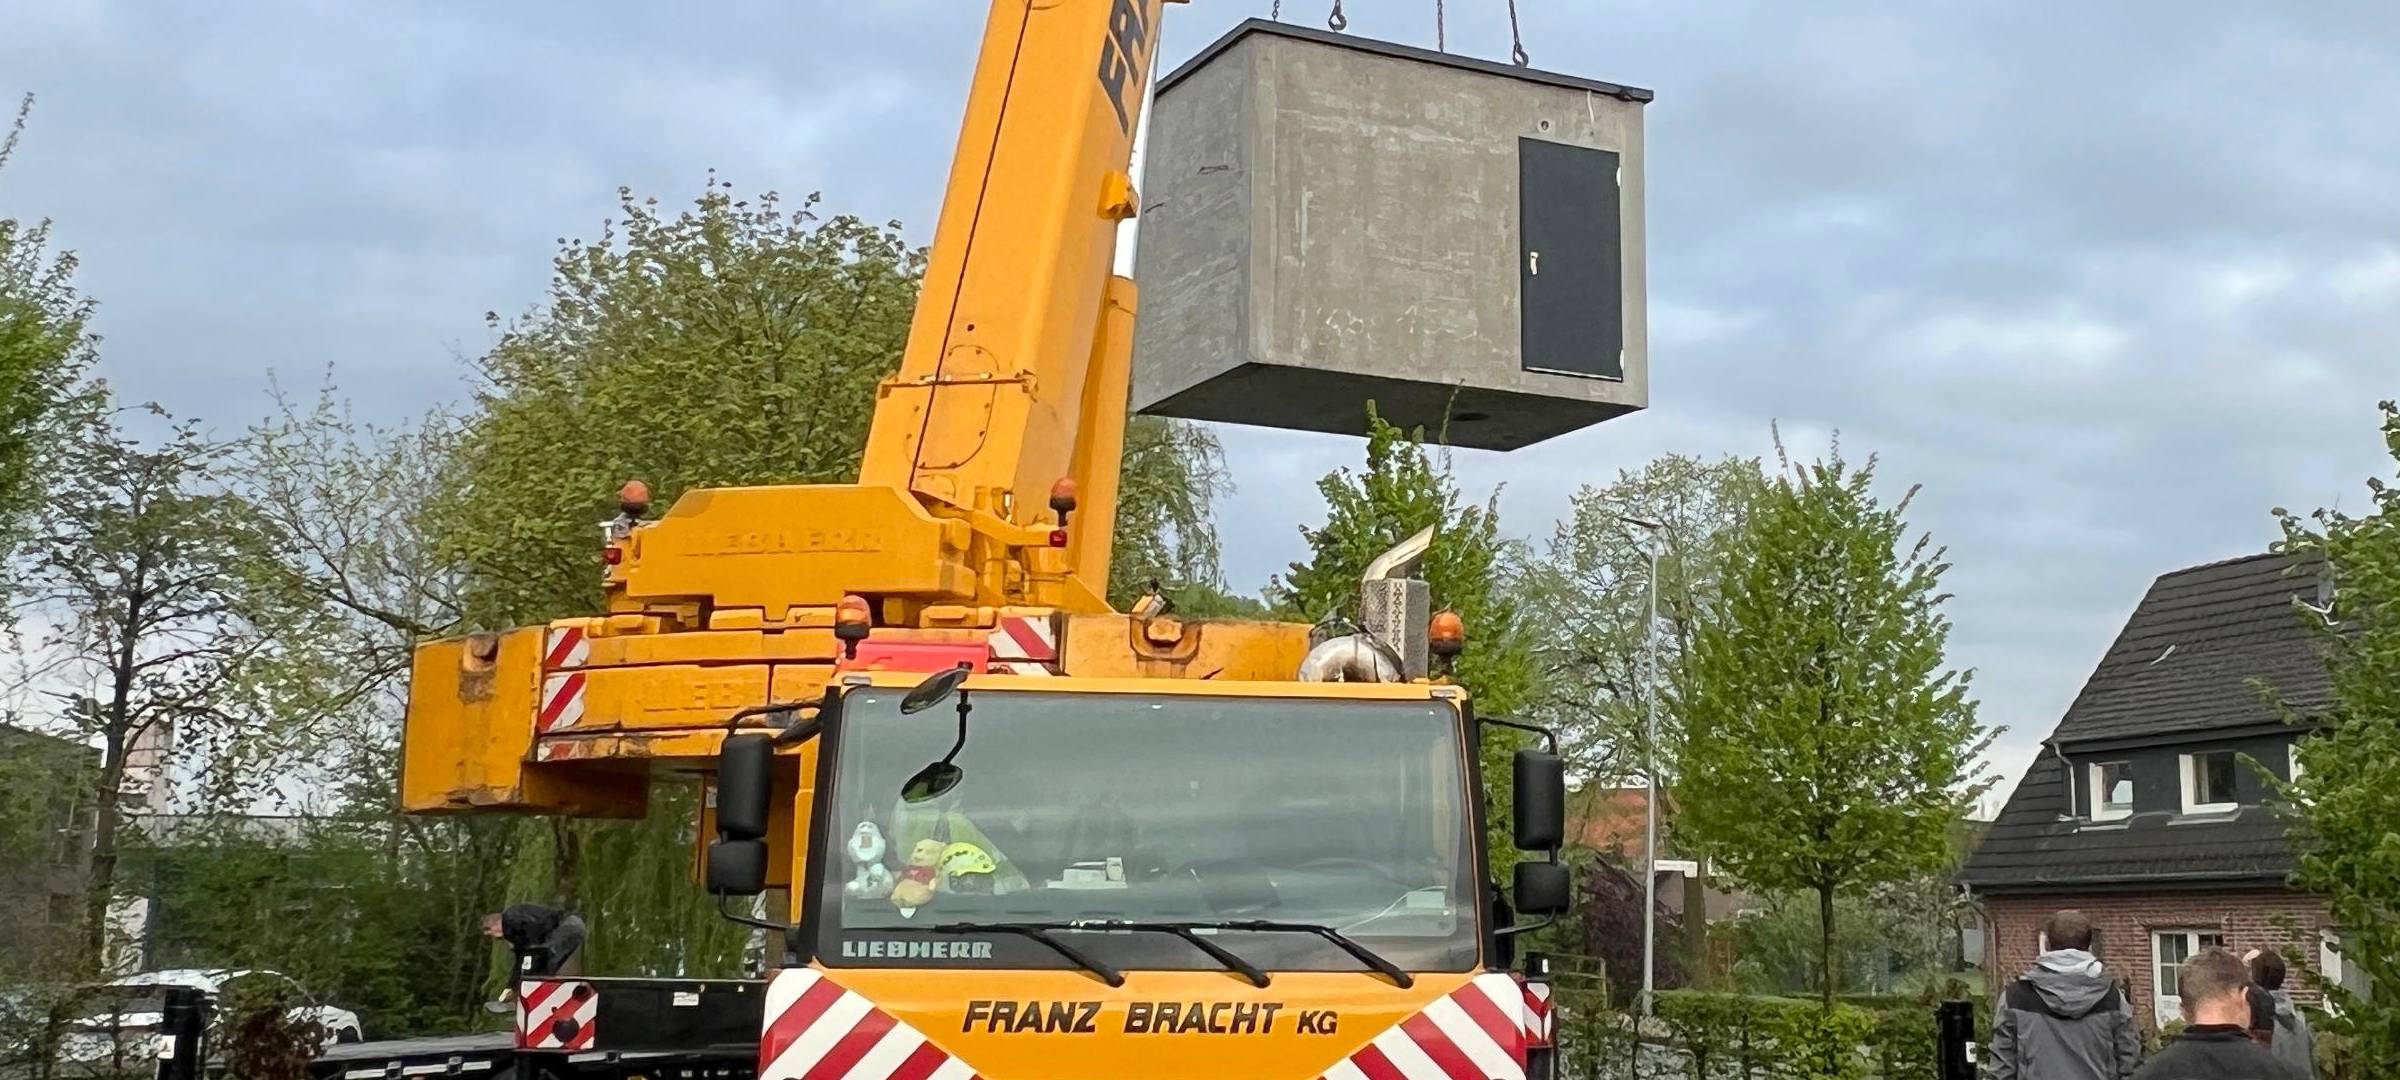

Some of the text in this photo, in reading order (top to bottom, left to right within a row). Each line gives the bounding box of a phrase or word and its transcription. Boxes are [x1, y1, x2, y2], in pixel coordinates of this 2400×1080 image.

[842, 940, 993, 959] LIEBHERR
[962, 1000, 1338, 1034] FRANZ BRACHT KG
